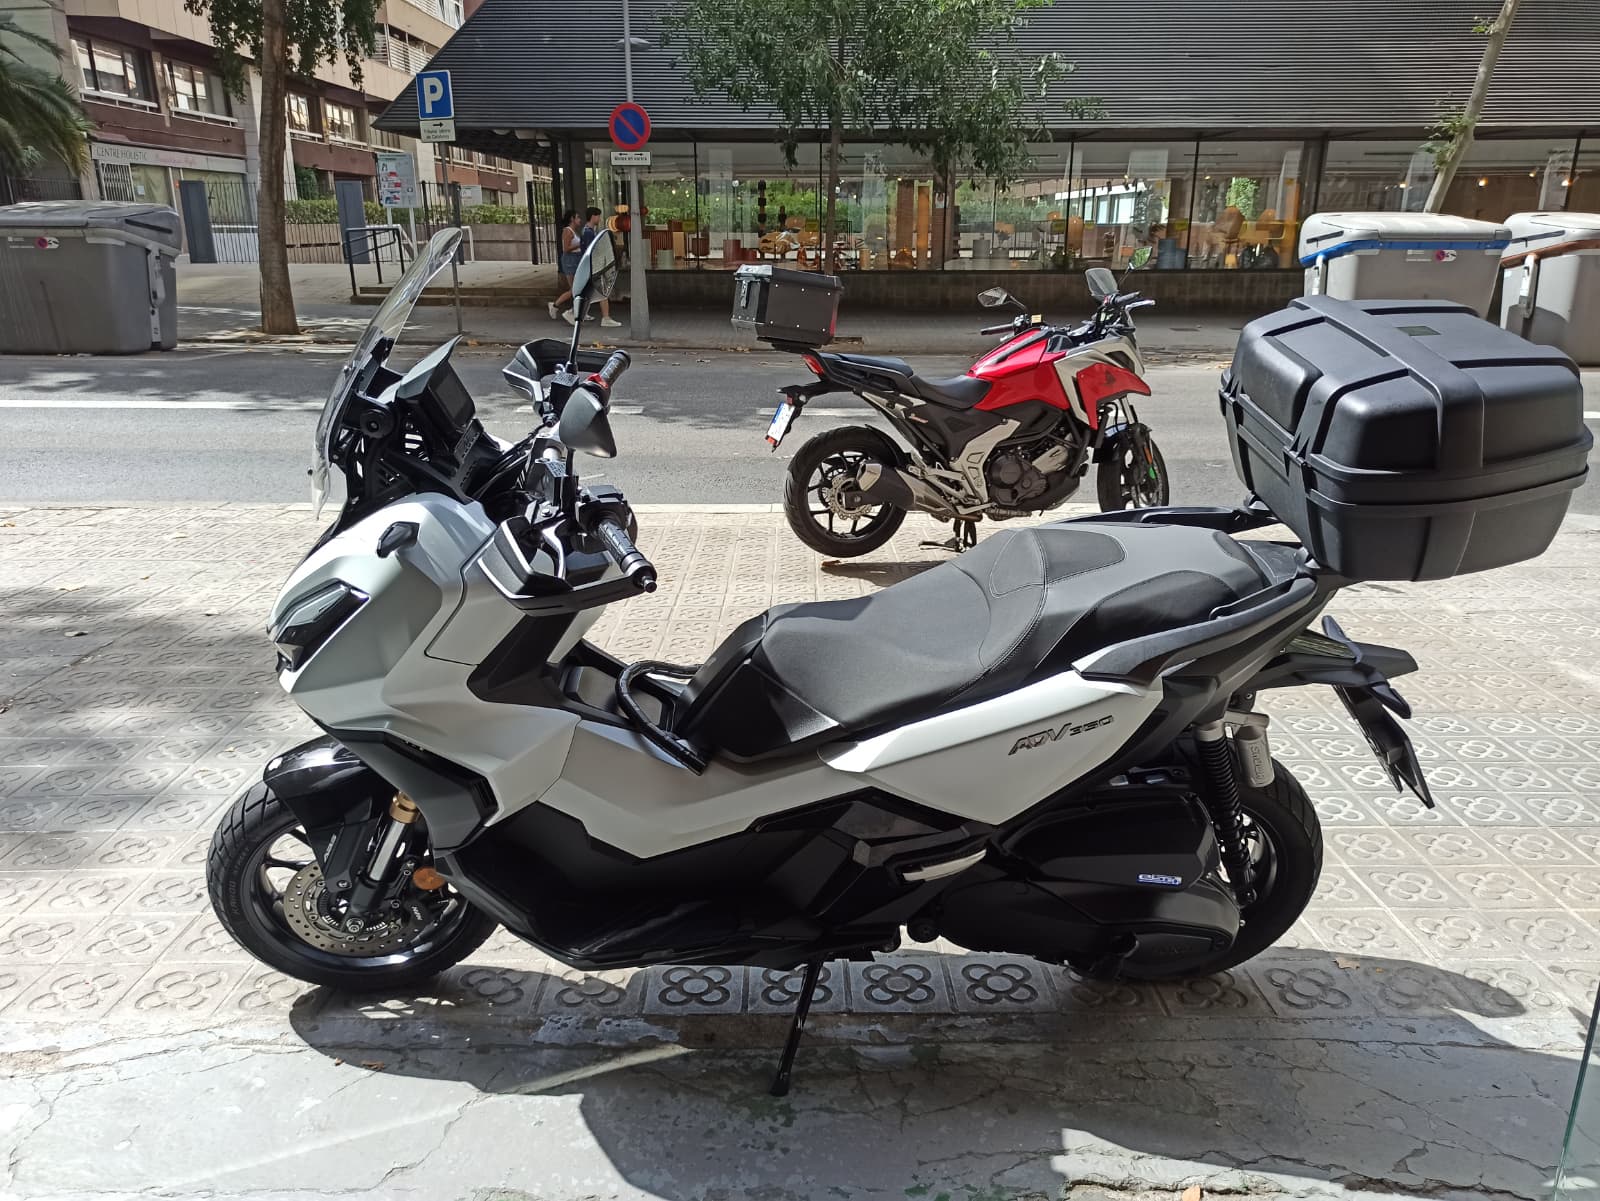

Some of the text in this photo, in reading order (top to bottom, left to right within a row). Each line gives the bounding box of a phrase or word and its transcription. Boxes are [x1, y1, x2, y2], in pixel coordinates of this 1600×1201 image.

[423, 77, 443, 113] P
[96, 146, 120, 159] CENTRE
[121, 150, 147, 161] HOLISTIC
